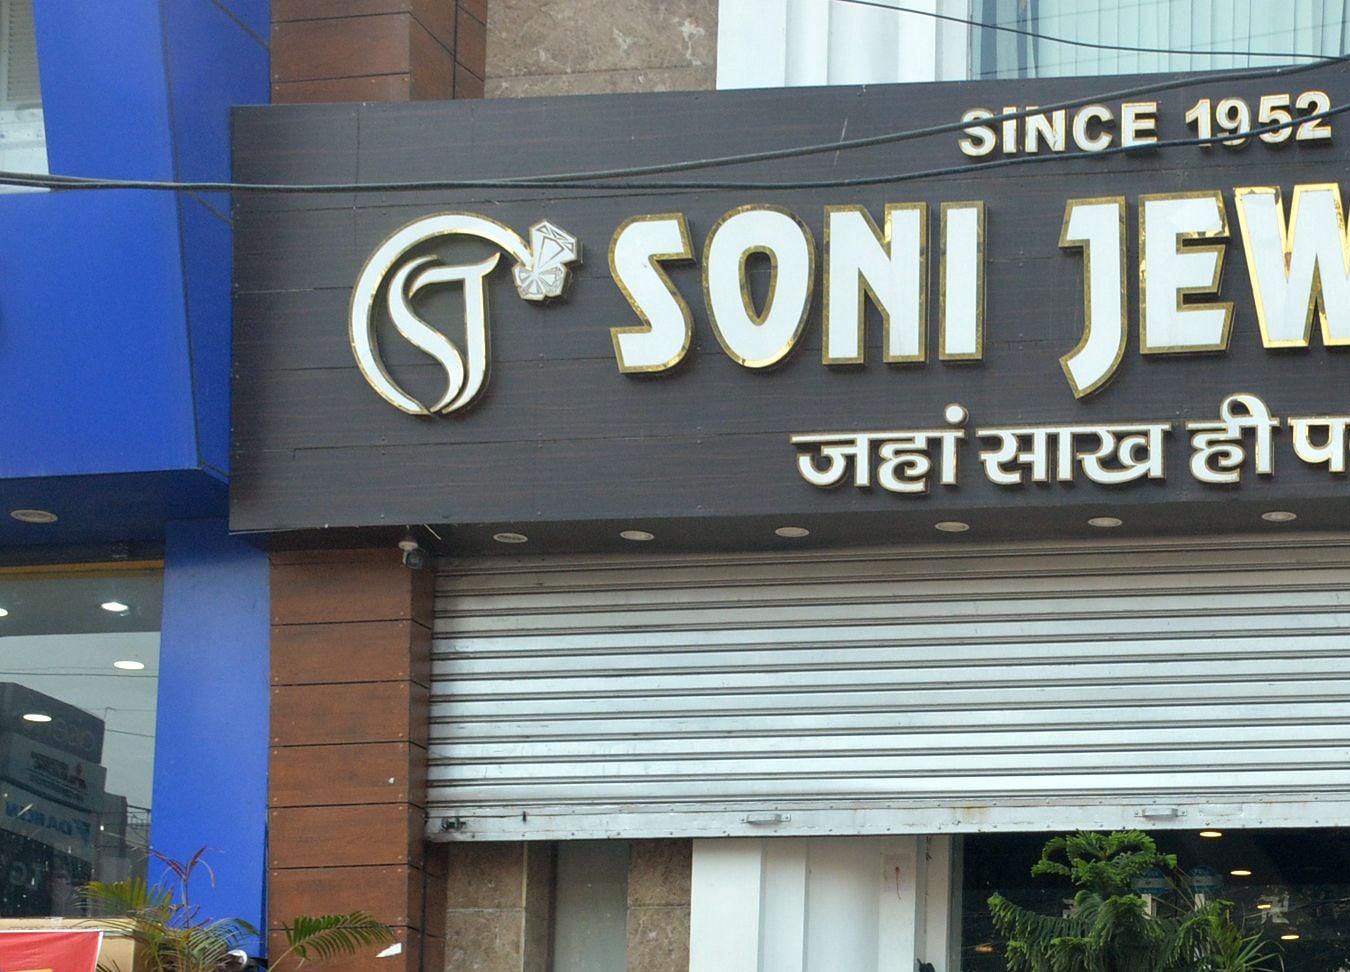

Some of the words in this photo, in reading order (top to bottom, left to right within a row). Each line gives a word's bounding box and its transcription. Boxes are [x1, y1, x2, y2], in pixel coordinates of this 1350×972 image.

[958, 101, 1158, 158] SINCE
[1185, 90, 1333, 148] 1952
[609, 199, 985, 376] SONI
[791, 403, 970, 496] जहां
[977, 421, 1173, 488] साख
[1185, 392, 1279, 485] ही
